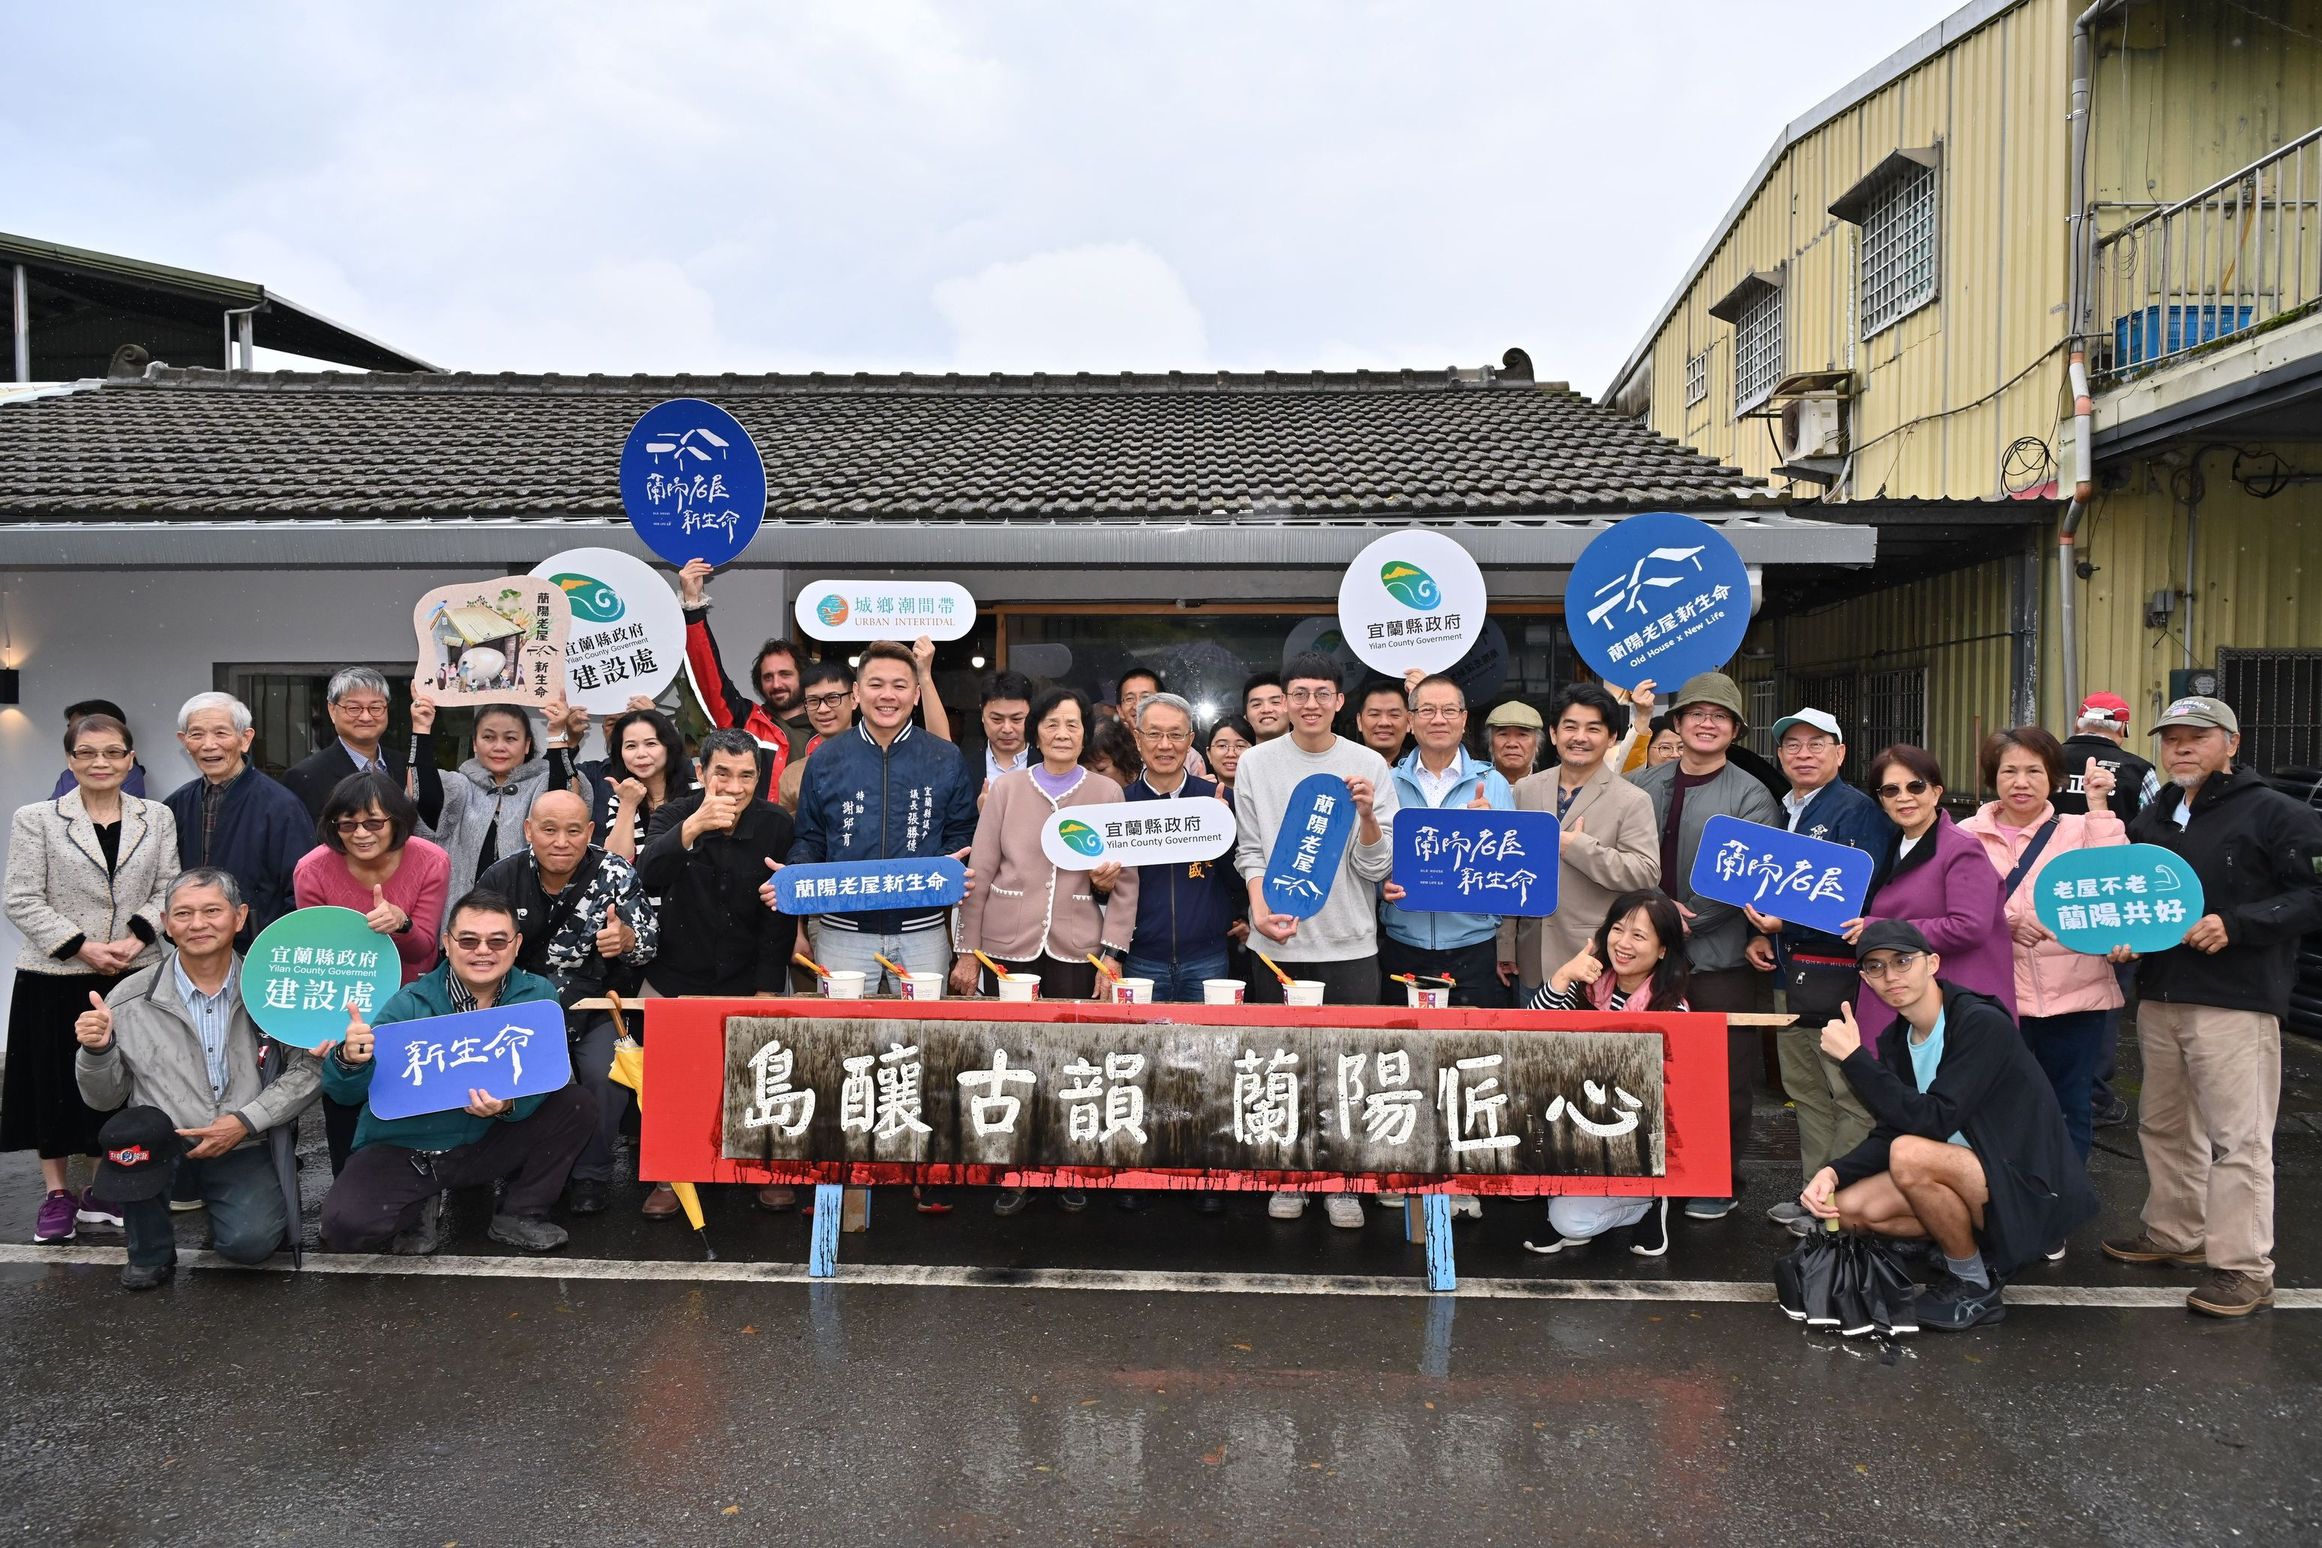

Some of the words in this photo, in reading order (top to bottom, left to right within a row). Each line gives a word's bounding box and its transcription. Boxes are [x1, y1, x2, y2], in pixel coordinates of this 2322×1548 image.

[647, 472, 730, 514] 蘭陽老屋
[681, 509, 740, 544] 新生命
[536, 592, 550, 641] 蘭陽老屋
[854, 596, 954, 615] 城鄉潮間帶
[855, 617, 890, 626] URBAN
[895, 617, 956, 627] INTERTIDAL
[1606, 583, 1732, 663] 蘭陽老屋新生命
[565, 622, 644, 657] 宜蘭縣政府
[1367, 613, 1462, 639] 宜蘭縣政府
[1368, 641, 1387, 651] Yilan
[1388, 637, 1415, 650] County
[1416, 633, 1463, 645] Government
[1630, 655, 1647, 668] Old
[1648, 639, 1675, 658] House
[1684, 623, 1705, 638] New
[1706, 610, 1725, 626] Life
[565, 654, 584, 665] Yilan
[584, 648, 610, 661] County
[610, 637, 649, 653] Goverment
[534, 661, 549, 698] 新生命
[569, 648, 659, 694] 建設處
[856, 790, 865, 814] 特助
[1105, 815, 1201, 838] 宜蘭縣政府
[1106, 840, 1129, 849] Yilan
[1130, 837, 1163, 848] County
[1165, 833, 1222, 845] Government
[1292, 794, 1337, 874] 蘭陽老屋
[1415, 826, 1526, 872] 蘭陽老屋
[795, 871, 949, 899] 蘭陽老屋新生命
[1457, 867, 1537, 907] 新生命
[1715, 839, 1846, 902] 蘭陽老屋
[2053, 874, 2148, 900] 老屋不老
[2056, 899, 2187, 931] 蘭陽共好
[268, 964, 291, 974] Yilan
[293, 965, 326, 977] County
[328, 967, 377, 977] Goverment
[270, 945, 379, 968] 宜蘭縣政府
[262, 977, 376, 1013] 建設處
[401, 1023, 535, 1087] 新生命
[1233, 1047, 1644, 1153] 蘭陽匠心
